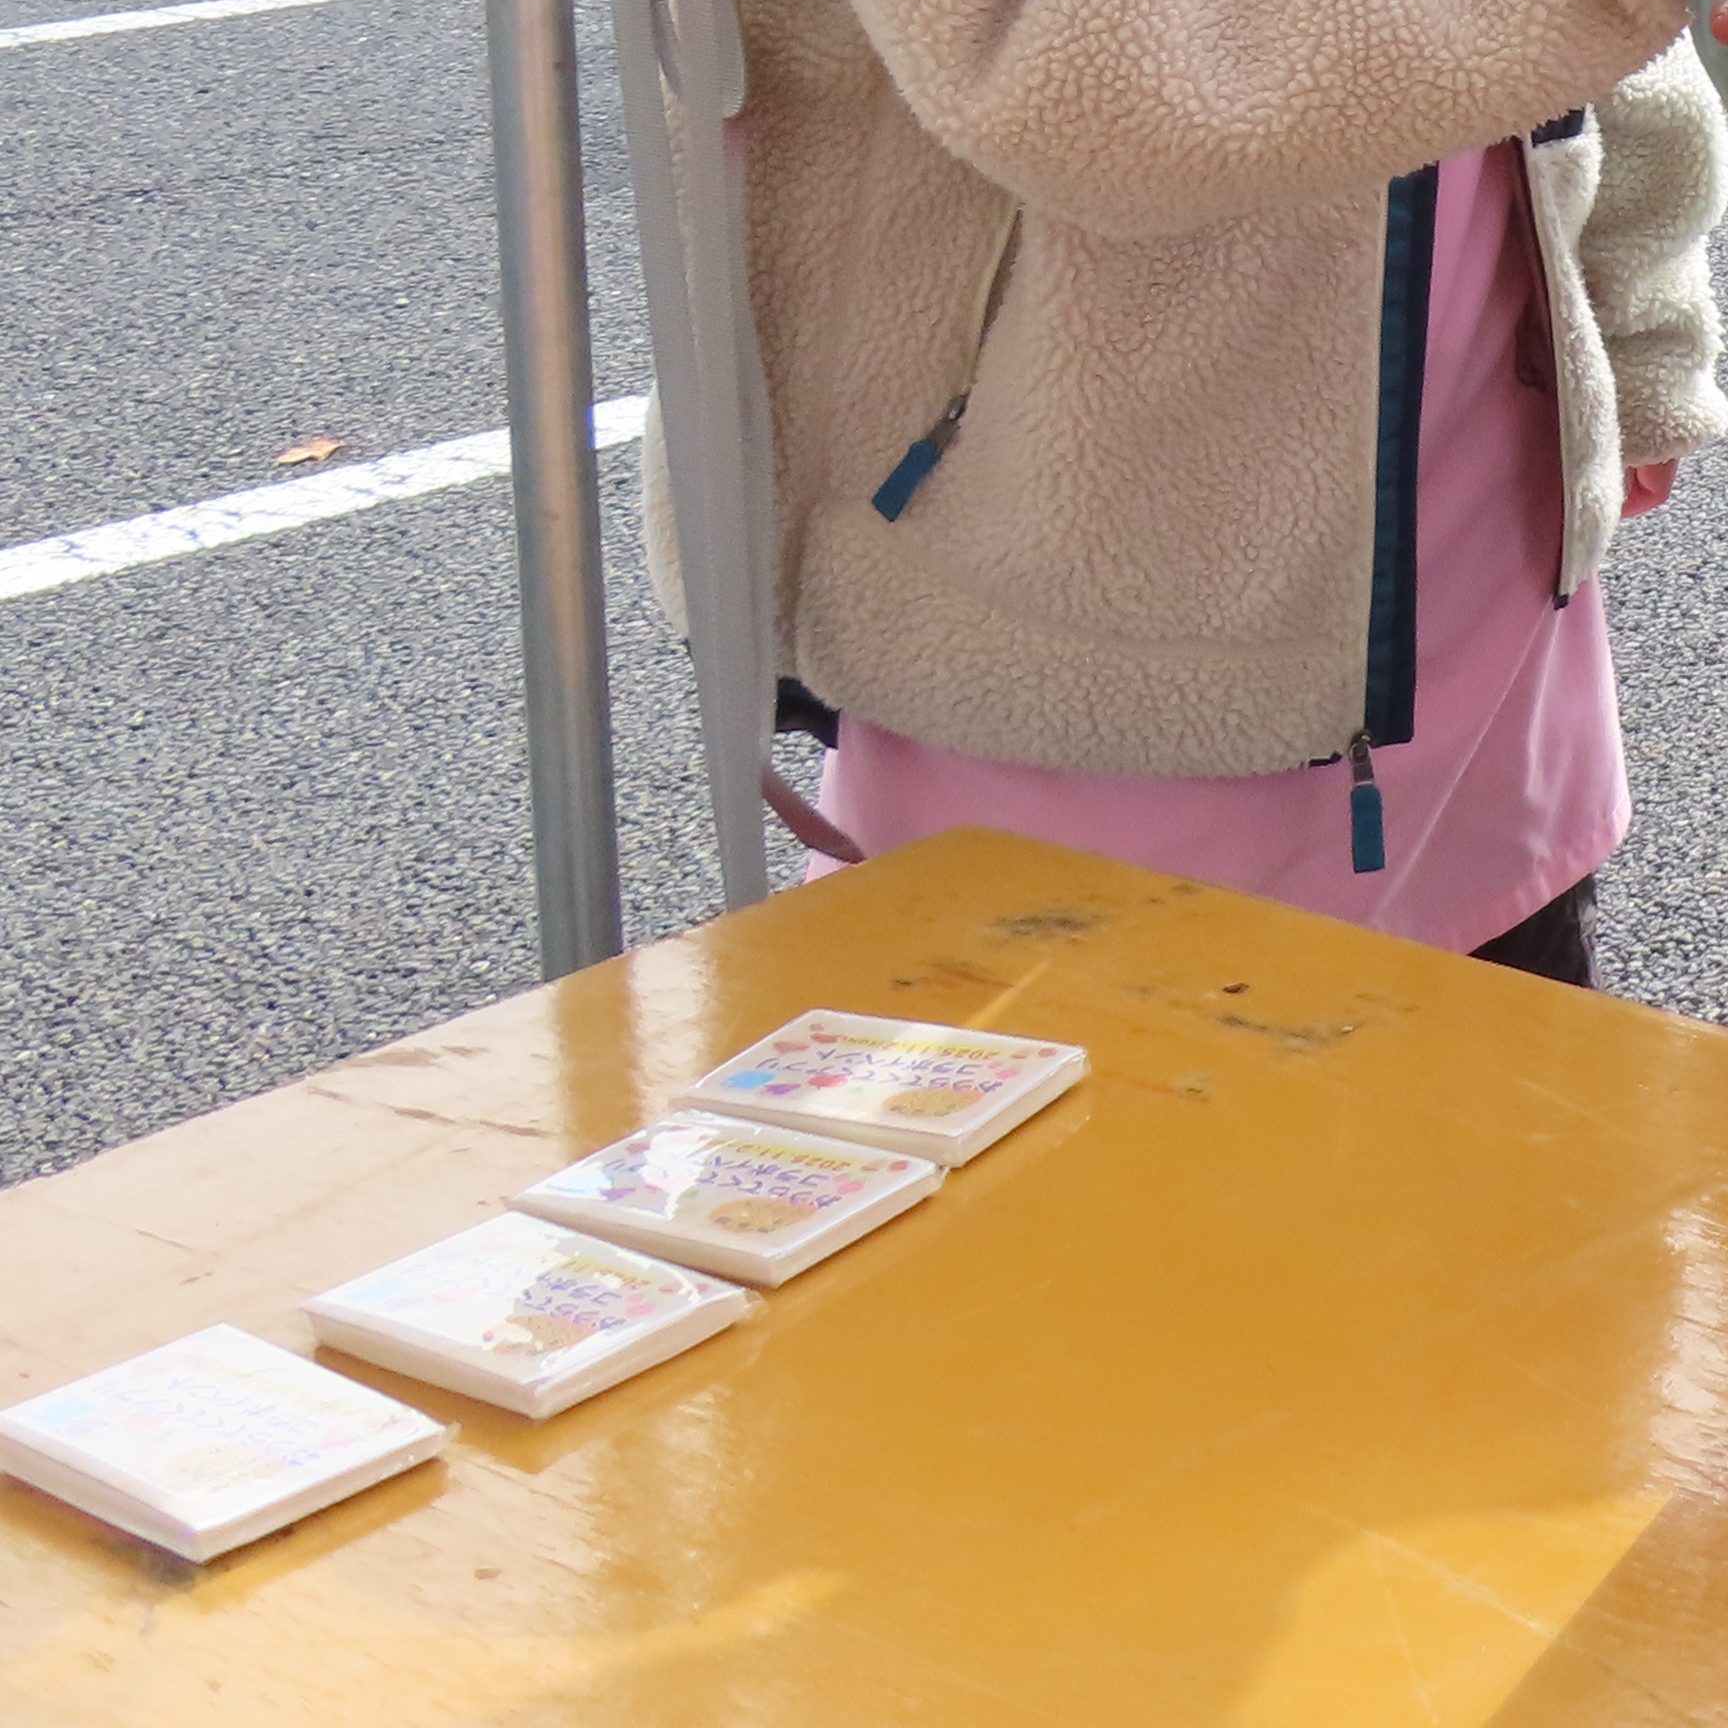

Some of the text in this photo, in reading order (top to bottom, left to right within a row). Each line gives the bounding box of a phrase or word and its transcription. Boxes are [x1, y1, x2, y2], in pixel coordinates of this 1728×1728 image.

[815, 1048, 983, 1076] コラボイベント
